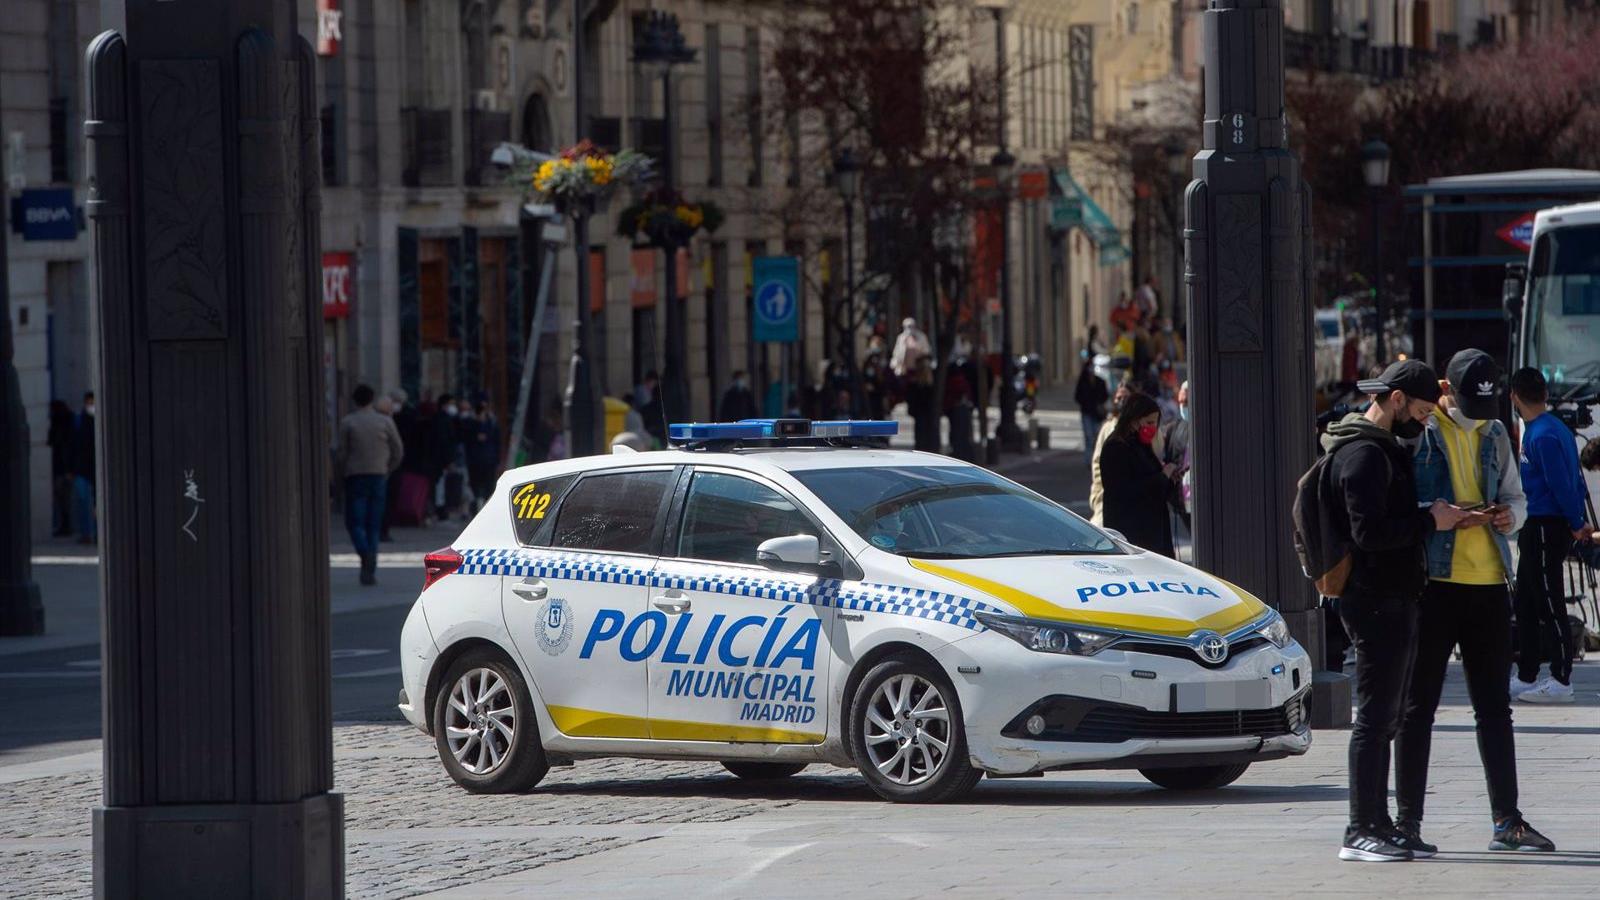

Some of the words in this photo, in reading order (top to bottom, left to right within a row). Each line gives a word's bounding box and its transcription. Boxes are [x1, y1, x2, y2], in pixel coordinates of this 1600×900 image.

[318, 11, 342, 40] KFC
[26, 207, 71, 223] BBVA
[517, 493, 551, 519] 112
[579, 605, 822, 670] POLICÍA
[666, 669, 816, 703] MUNICIPAL
[740, 703, 816, 724] MADRID
